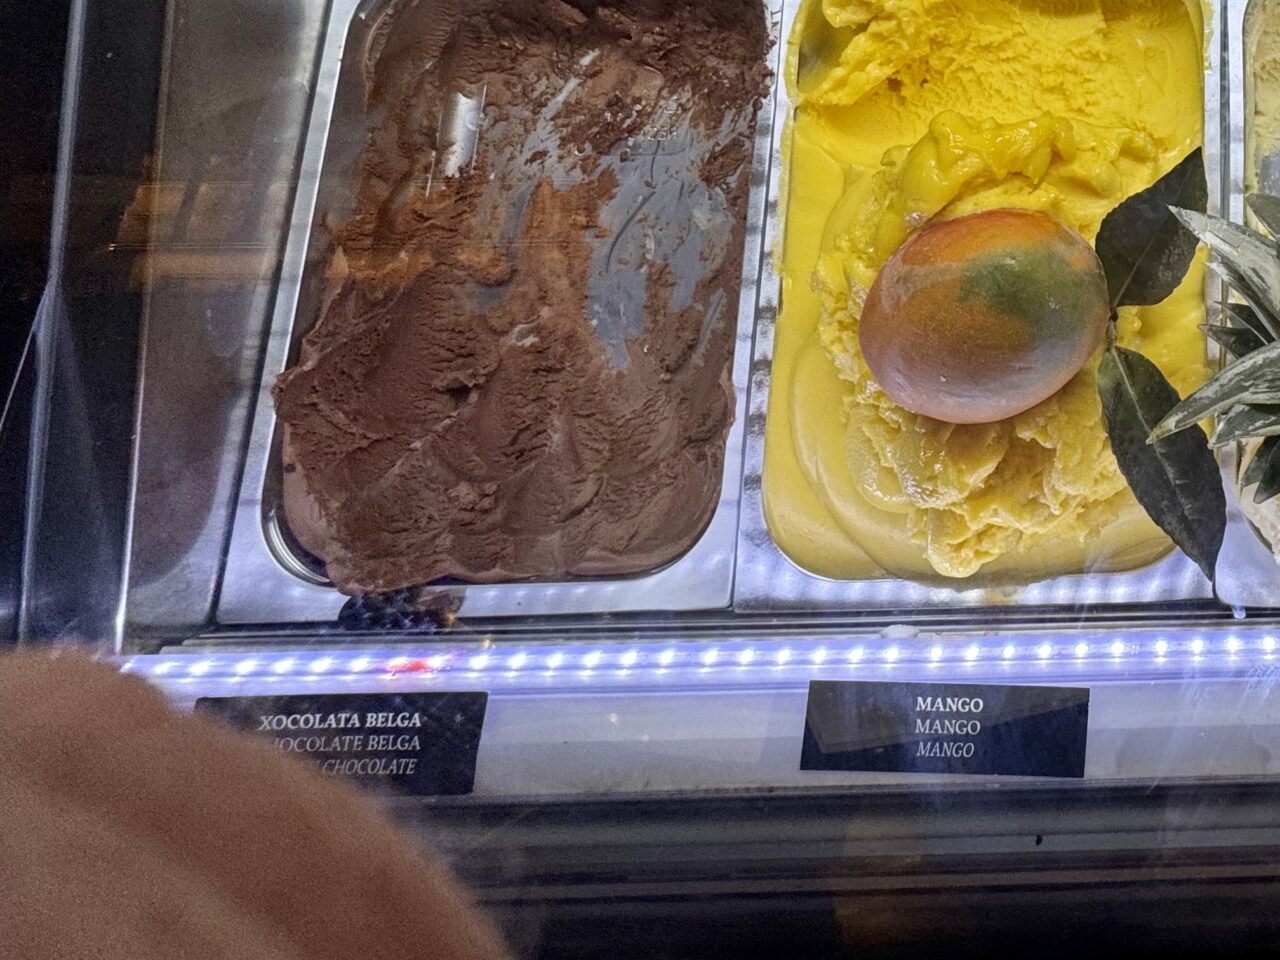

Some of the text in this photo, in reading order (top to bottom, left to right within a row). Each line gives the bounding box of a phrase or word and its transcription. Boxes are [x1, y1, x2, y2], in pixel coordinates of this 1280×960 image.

[915, 696, 985, 713] MANGO
[258, 711, 422, 731] XOCOLATA BELGA
[914, 718, 982, 735] MANGO
[273, 734, 422, 753] OCOLATE BELGA
[915, 741, 976, 758] MANGO
[322, 757, 418, 776] CHOCOLATE
